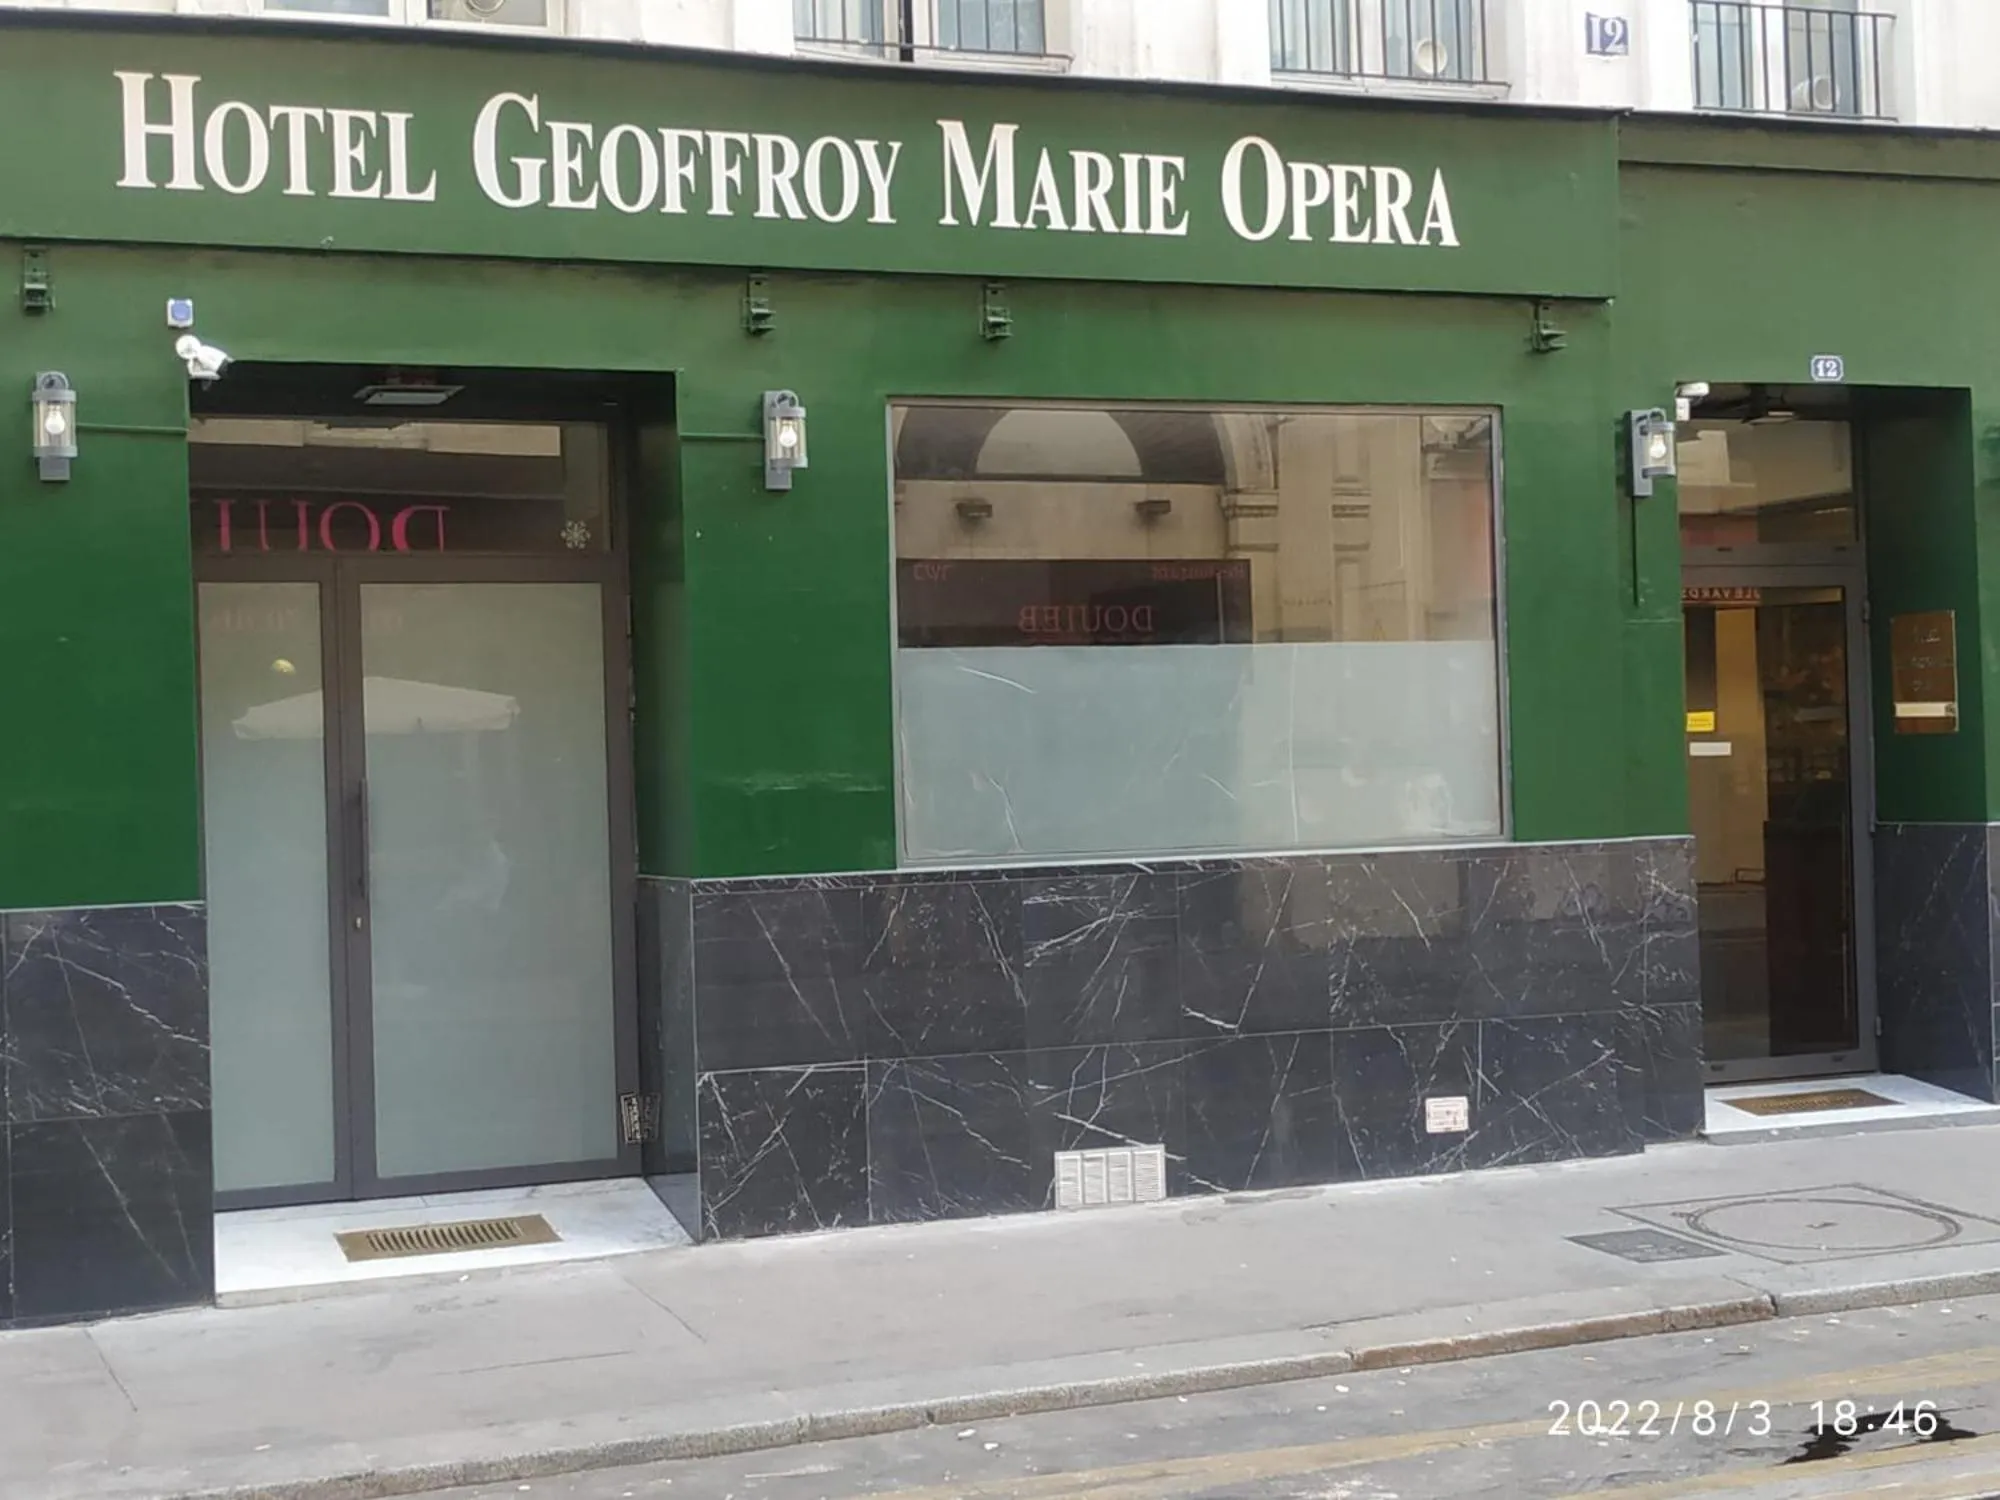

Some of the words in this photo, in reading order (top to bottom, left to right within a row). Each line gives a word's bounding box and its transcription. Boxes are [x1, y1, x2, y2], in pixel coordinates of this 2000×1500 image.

[1589, 16, 1627, 53] 12
[114, 72, 436, 201] HOTEL
[474, 93, 902, 223] GEOFFROY
[938, 121, 1188, 235] MARIE
[1222, 137, 1459, 246] OPERA
[1816, 359, 1838, 377] 12
